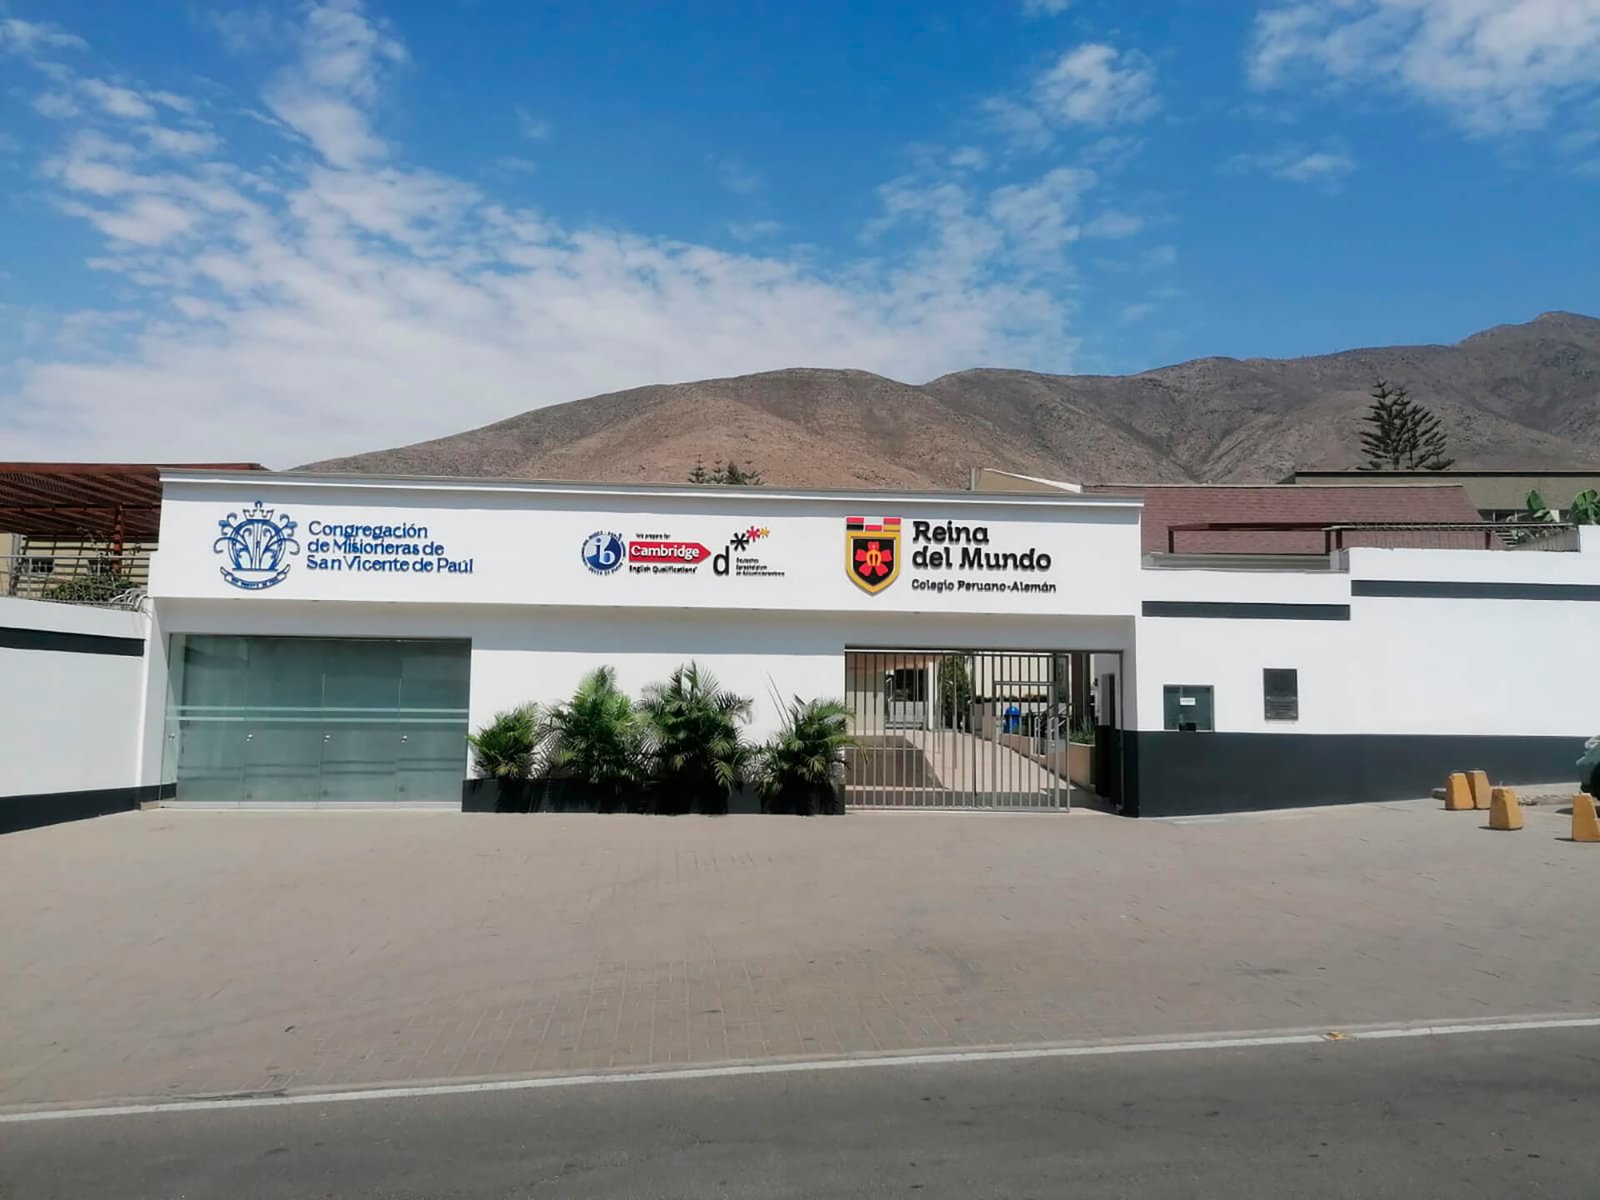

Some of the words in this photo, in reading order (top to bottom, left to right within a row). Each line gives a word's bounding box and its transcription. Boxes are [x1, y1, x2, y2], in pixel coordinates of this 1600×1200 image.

[308, 521, 428, 540] Congregación
[913, 521, 989, 543] Reina
[307, 539, 330, 553] de
[333, 538, 420, 556] Misioneras
[422, 541, 444, 556] de
[631, 545, 700, 560] Cambridge
[307, 555, 341, 571] San
[343, 556, 410, 572] Vicente
[412, 557, 434, 573] de
[437, 557, 474, 574] Paúl
[912, 546, 953, 568] del
[959, 548, 1052, 571] Mundo
[629, 565, 651, 574] English
[912, 578, 955, 593] Colegio
[957, 580, 1057, 593] Peruano-Alemán
